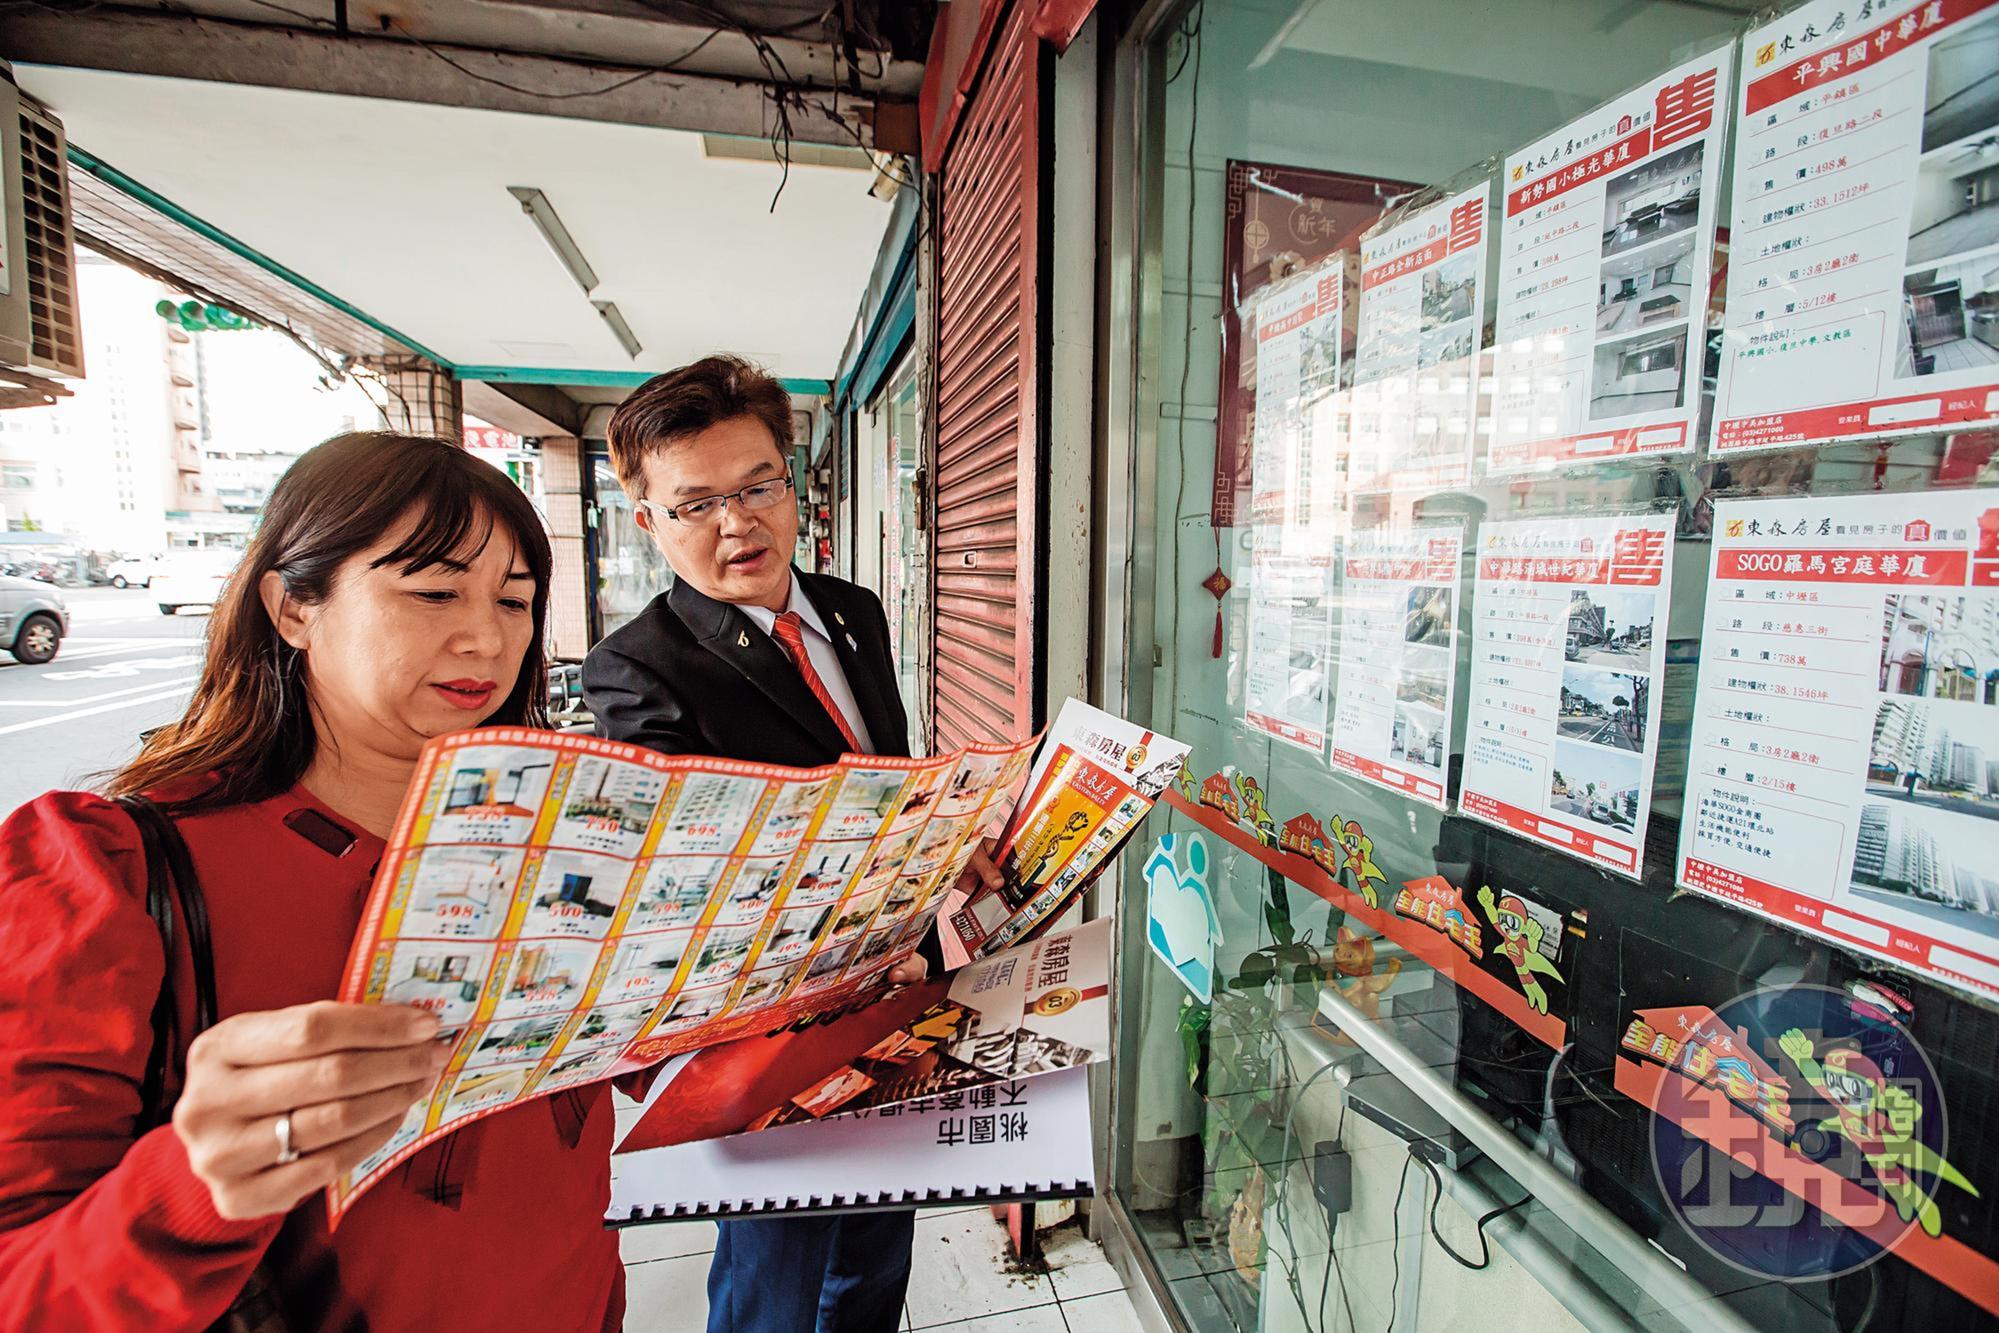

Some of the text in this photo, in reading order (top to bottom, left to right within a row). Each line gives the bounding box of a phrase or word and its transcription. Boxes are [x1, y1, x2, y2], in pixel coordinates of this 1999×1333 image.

[1792, 0, 1945, 85] 平興國中華廈
[1652, 67, 1718, 153] 售
[1519, 142, 1632, 205] 新勢國小極光華廈
[1449, 197, 1484, 256] 售
[1317, 274, 1339, 315] 售
[1610, 528, 1666, 586] 售
[1747, 518, 1833, 538] 東森房屋
[1737, 553, 1930, 579] SOGO羅馬宮庭華廈
[1396, 888, 1483, 961] 全能住宅王
[1621, 1018, 1797, 1136] 全能住宅王
[936, 1111, 1028, 1146] 桃園市
